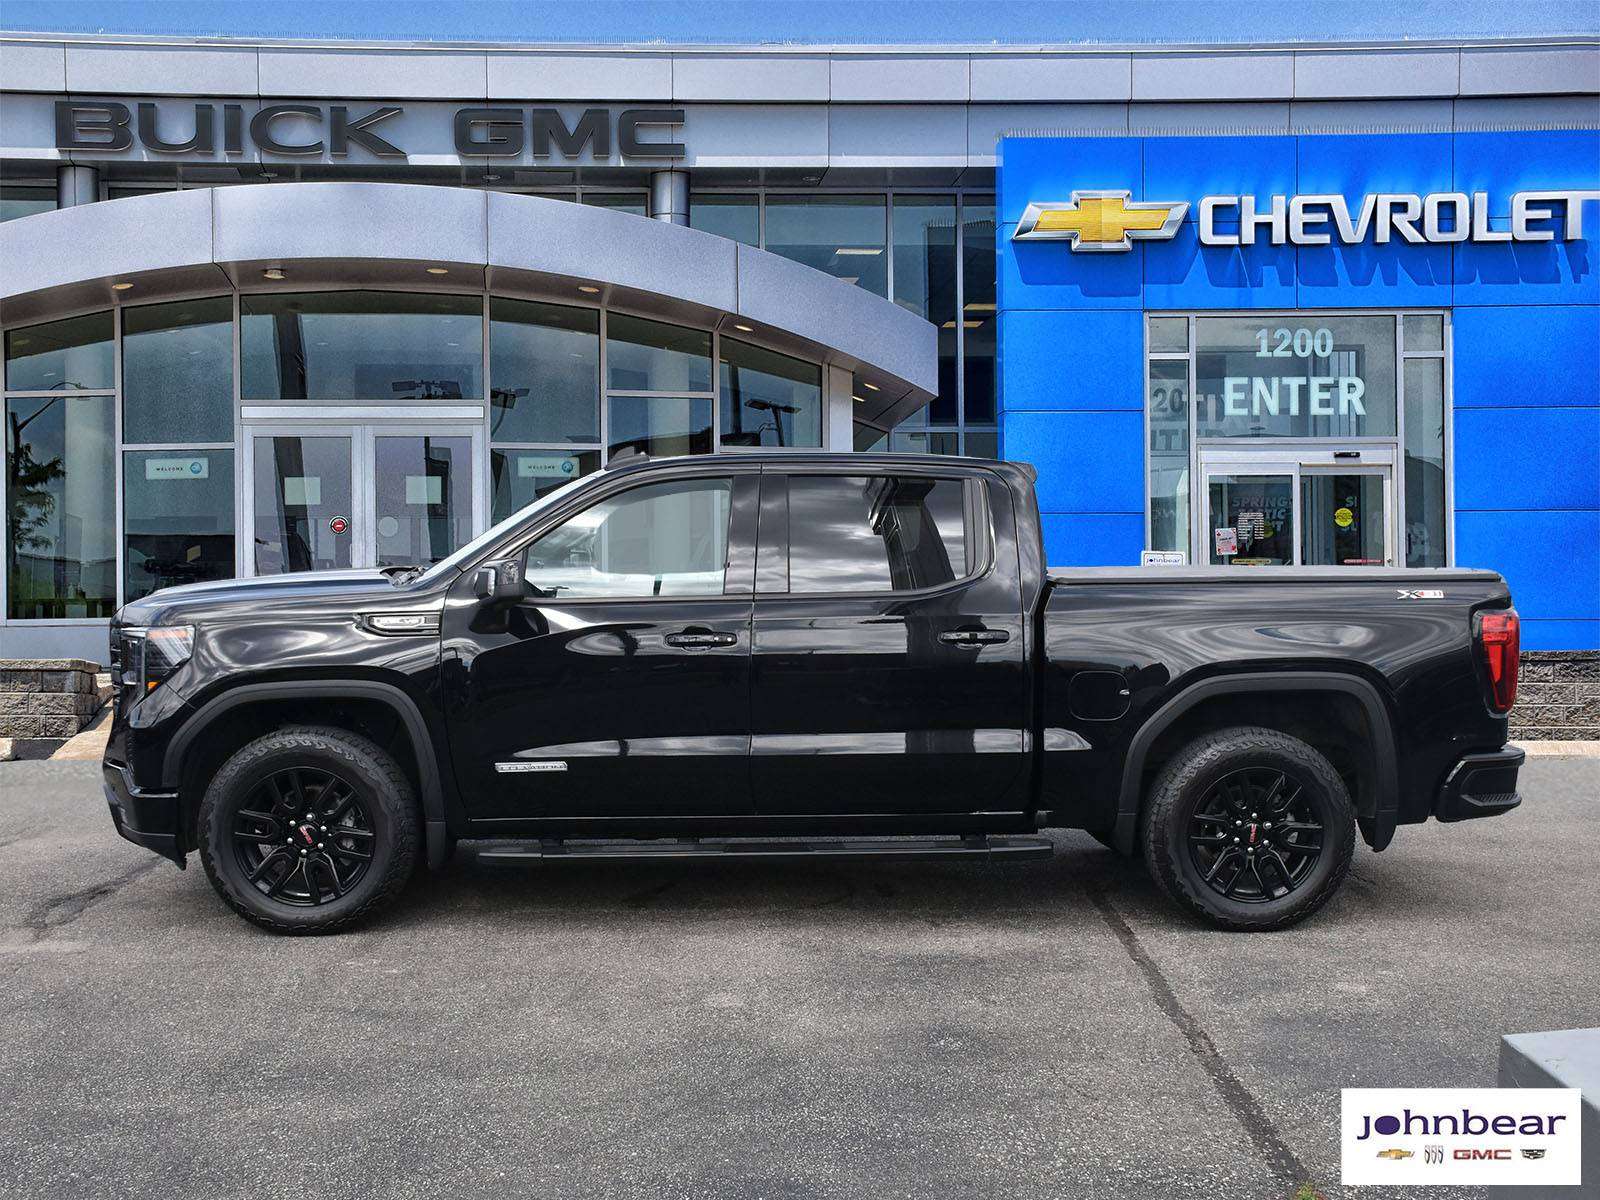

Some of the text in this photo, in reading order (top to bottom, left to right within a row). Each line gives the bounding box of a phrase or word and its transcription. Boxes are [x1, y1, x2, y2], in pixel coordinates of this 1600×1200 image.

[55, 101, 685, 158] BUICK GMC
[1199, 190, 1600, 246] CHEVROLET
[1255, 327, 1334, 358] 1200
[1223, 376, 1367, 416] ENTER
